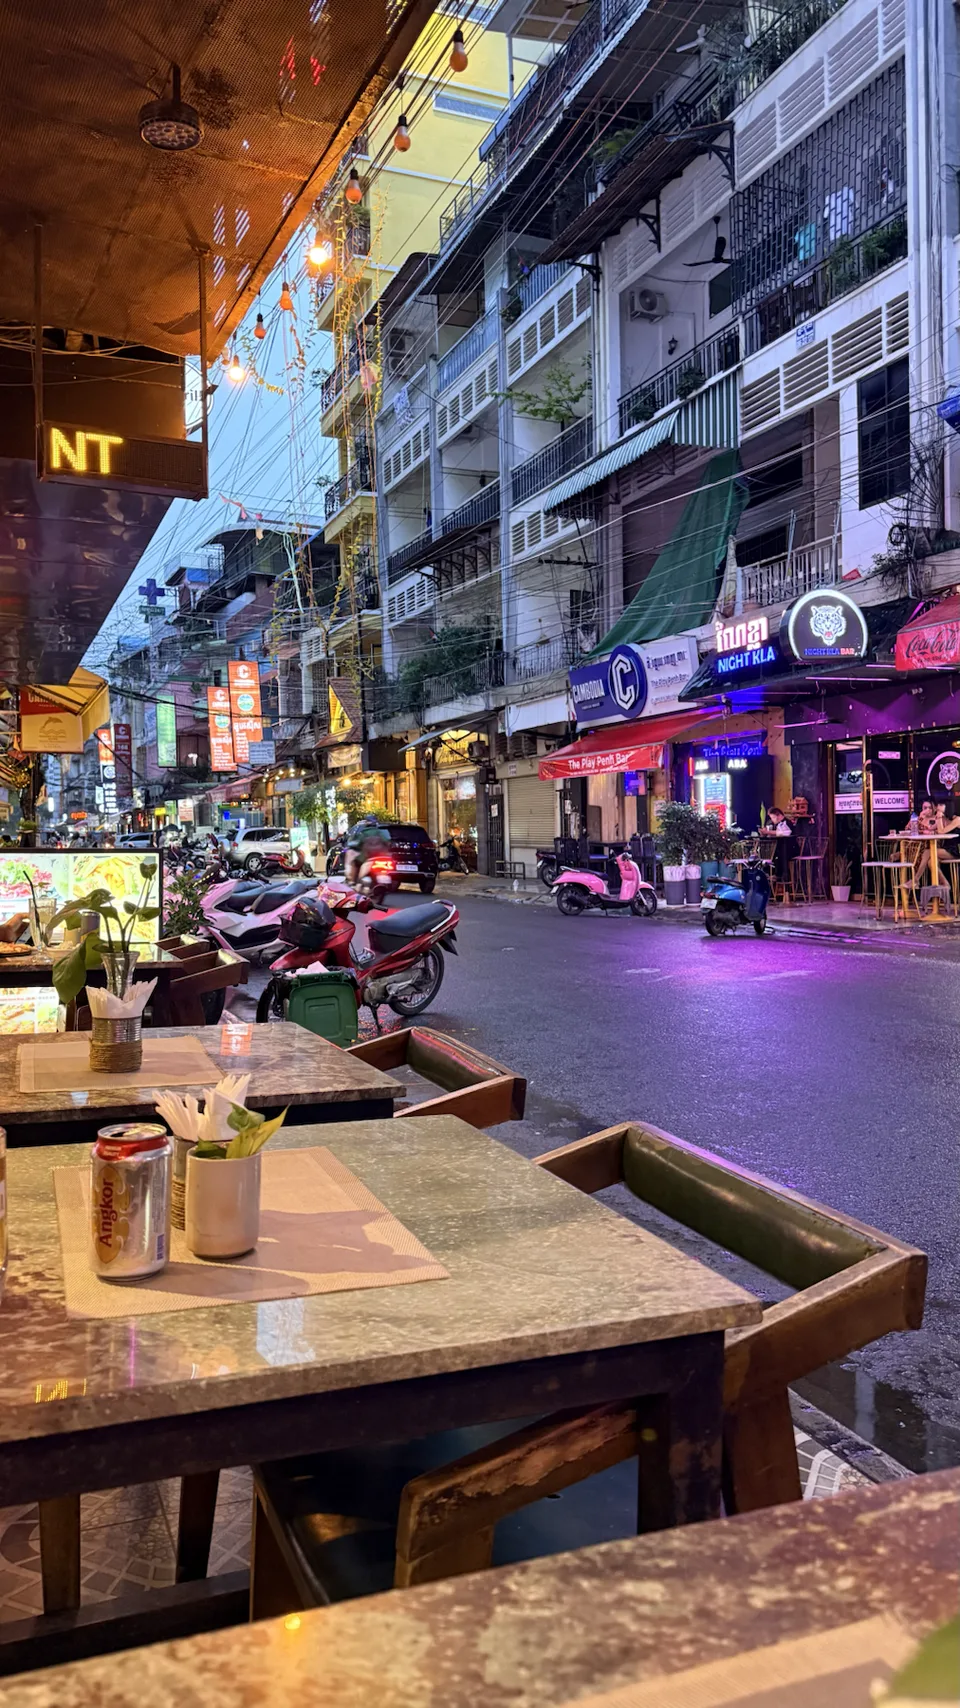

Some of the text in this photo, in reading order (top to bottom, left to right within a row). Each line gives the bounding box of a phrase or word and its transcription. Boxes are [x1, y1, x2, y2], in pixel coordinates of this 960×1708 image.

[51, 427, 123, 474] NT
[718, 646, 776, 673] NIGHT KLA
[804, 646, 855, 656] NIGHT KLA BAR
[572, 679, 605, 704] CAMBODIA
[568, 759, 580, 770] The
[581, 756, 596, 769] Play
[597, 753, 615, 766] Penh
[615, 753, 629, 764] Bar
[728, 759, 748, 769] ABA
[100, 1179, 117, 1248] Angkor
